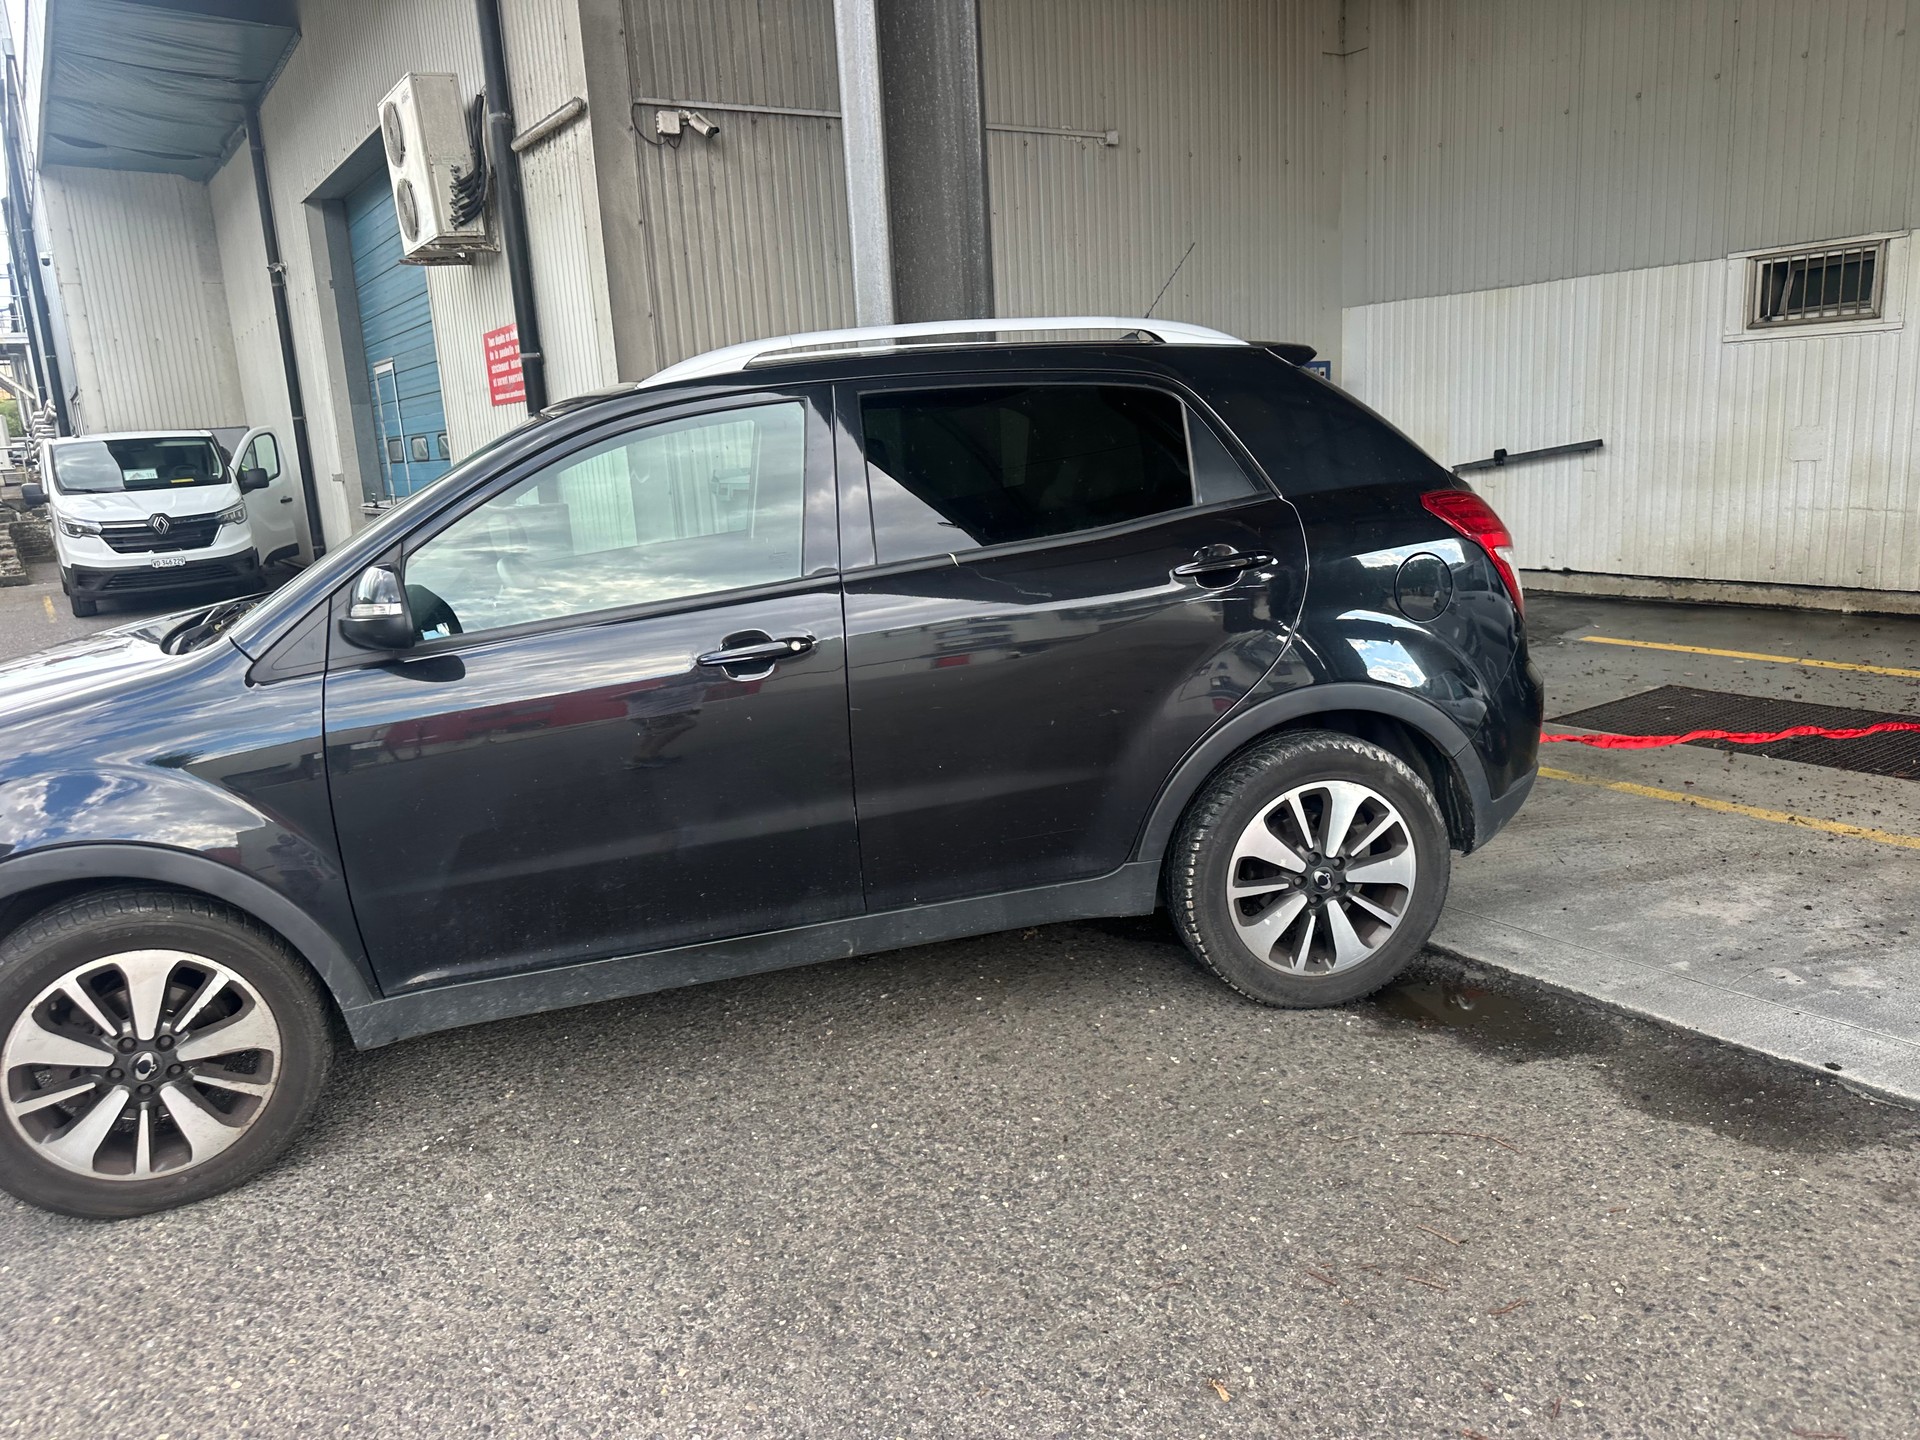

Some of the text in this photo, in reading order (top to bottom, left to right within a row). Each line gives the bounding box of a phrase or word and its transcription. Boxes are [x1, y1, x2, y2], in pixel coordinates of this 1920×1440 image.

[489, 351, 494, 361] de
[498, 345, 514, 358] poubelle
[491, 361, 510, 374] strictement
[162, 558, 172, 566] 346
[173, 557, 184, 565] 229
